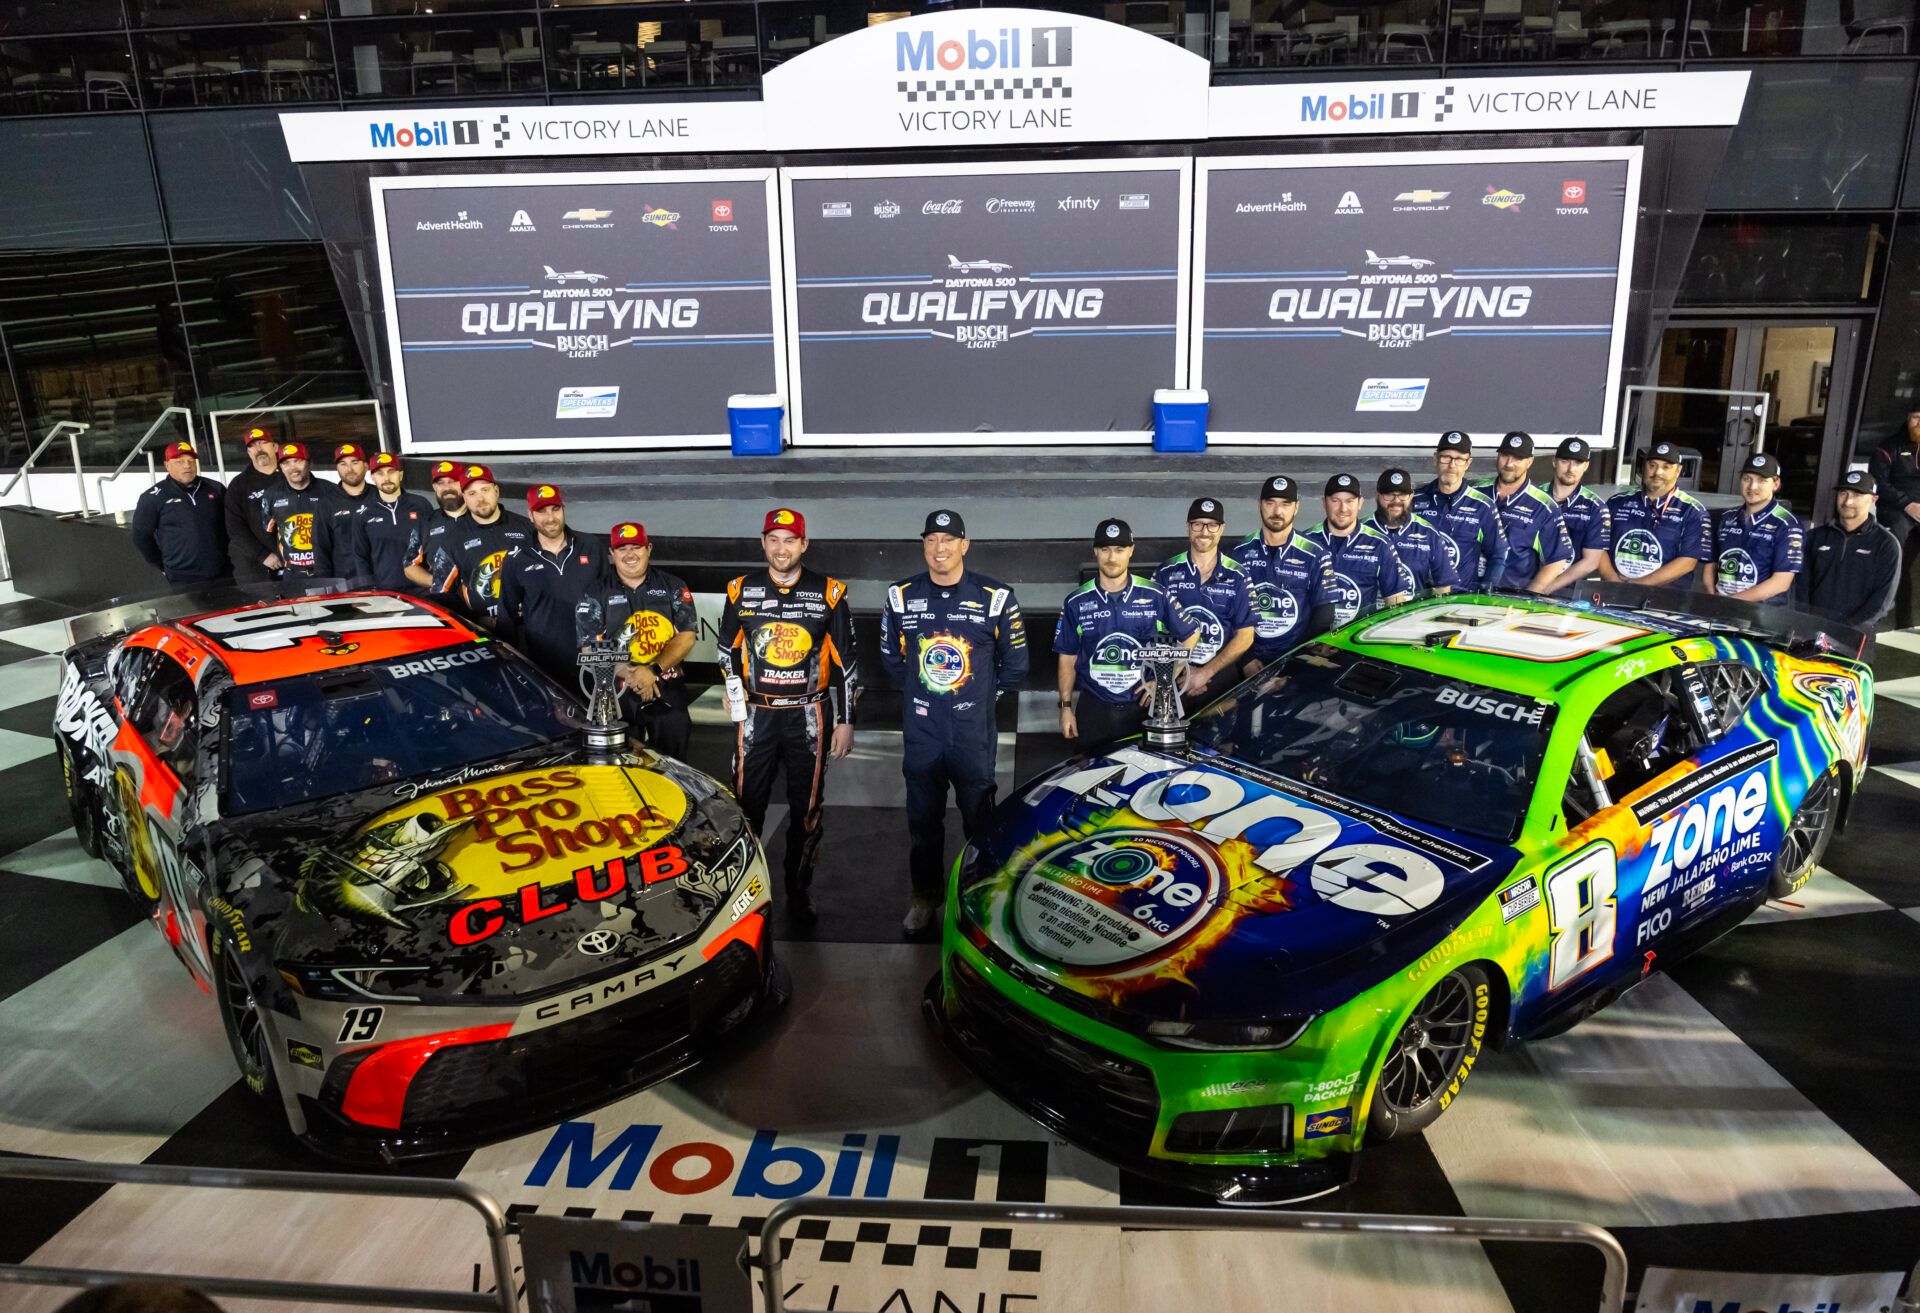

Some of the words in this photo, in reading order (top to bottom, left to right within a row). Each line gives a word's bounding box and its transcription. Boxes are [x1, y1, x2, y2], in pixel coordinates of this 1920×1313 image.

[896, 28, 1020, 71] Mobil
[1301, 94, 1384, 122] Mobil
[1467, 91, 1580, 114] VICTORY
[1588, 89, 1658, 110] LANE
[521, 120, 621, 141] VICTORY
[629, 118, 690, 138] LANE
[898, 110, 1001, 132] VICTORY
[1009, 108, 1072, 129] LANE
[370, 121, 448, 148] Mobil
[874, 205, 900, 215] BUSCH
[1000, 198, 1036, 210] Freeway
[1057, 196, 1101, 212] xfinity
[1235, 202, 1307, 213] AdventHealth
[1483, 195, 1524, 204] SUNOCO
[643, 213, 679, 223] SUNOCO
[1556, 207, 1589, 215] TOYOTA
[416, 220, 483, 231] AdventHealth
[945, 278, 993, 288] DAYTONA
[995, 278, 1016, 287] 500
[1360, 275, 1412, 285] DAYTONA
[1413, 274, 1438, 284] 500
[543, 289, 590, 298] DAYTONA
[593, 288, 613, 297] 500
[861, 288, 1104, 325] QUALIFYING
[1268, 286, 1533, 322] QUALIFYING
[461, 298, 700, 335] QUALIFYING
[956, 325, 1009, 342] BUSCH
[1368, 324, 1425, 341] BUSCH
[556, 335, 609, 352] BUSCH
[965, 341, 999, 349] LIGHT
[1378, 339, 1412, 348] LIGHT
[567, 350, 599, 359] LIGHT
[1631, 508, 1646, 517] FICO
[1729, 527, 1743, 535] FICO
[1622, 538, 1659, 554] zone
[1720, 558, 1753, 574] zone
[795, 591, 823, 599] TOYOTA
[1179, 582, 1195, 590] FICO
[635, 614, 660, 628] Bass
[1093, 610, 1111, 619] FICO
[638, 629, 657, 640] Pro
[773, 623, 799, 637] Bass
[1200, 622, 1220, 635] ne
[388, 647, 495, 679] BRISCOE
[580, 654, 630, 663] QUALIFYING
[773, 648, 805, 662] Shops
[1138, 650, 1188, 658] QUALIFYING
[764, 669, 805, 679] TRACKER
[1436, 688, 1534, 723] BUSCH
[436, 770, 586, 822] Bass
[472, 796, 582, 843] Pro
[1235, 766, 1271, 783] contains
[1271, 779, 1309, 796] nicotine.
[1310, 793, 1350, 811] Nicotine
[1350, 807, 1360, 815] is
[1360, 811, 1375, 821] an
[1421, 837, 1471, 863] chemical.
[495, 802, 675, 874] Shops
[1024, 748, 1445, 917] zone
[1641, 771, 1768, 895] zone
[1144, 837, 1179, 851] NICOTINE
[1176, 847, 1201, 869] POUCHES
[1731, 857, 1748, 873] Bank
[1747, 851, 1772, 868] OZK
[1071, 840, 1202, 907] zone
[1640, 882, 1669, 914] NEW
[1670, 846, 1730, 894] JALAPEÑO
[1730, 831, 1761, 858] LIME
[448, 845, 690, 947] CLUB
[1081, 879, 1105, 897] LIME
[1510, 879, 1532, 899] NASCAR
[1041, 880, 1085, 909] WARNING:
[1081, 902, 1100, 919] This
[1098, 911, 1133, 937] product
[1507, 901, 1518, 915] CUP
[1518, 891, 1535, 909] SERIES
[207, 896, 252, 952] GOODYEAR
[1028, 891, 1060, 912] contains
[1058, 905, 1091, 929] nicotine.
[1091, 923, 1128, 948] Nicotine
[1133, 902, 1153, 921] 6
[1148, 915, 1170, 933] MG
[1548, 840, 1617, 991] 8
[1038, 909, 1048, 921] is
[1048, 914, 1058, 925] an
[1056, 919, 1095, 945] addictive
[1038, 923, 1077, 950] chemical
[1636, 907, 1673, 947] FICO
[1408, 925, 1494, 982] GOODYEAR
[536, 954, 690, 1021] CAMRY
[338, 1007, 383, 1042] 19
[291, 1049, 321, 1064] SUNOCO
[1438, 983, 1489, 1112] GOODYEAR
[1303, 1083, 1363, 1103] PACK-RAT
[1306, 1116, 1350, 1131] SUNOCO
[524, 1121, 901, 1200] Mobil
[569, 1250, 701, 1293] Mobil
